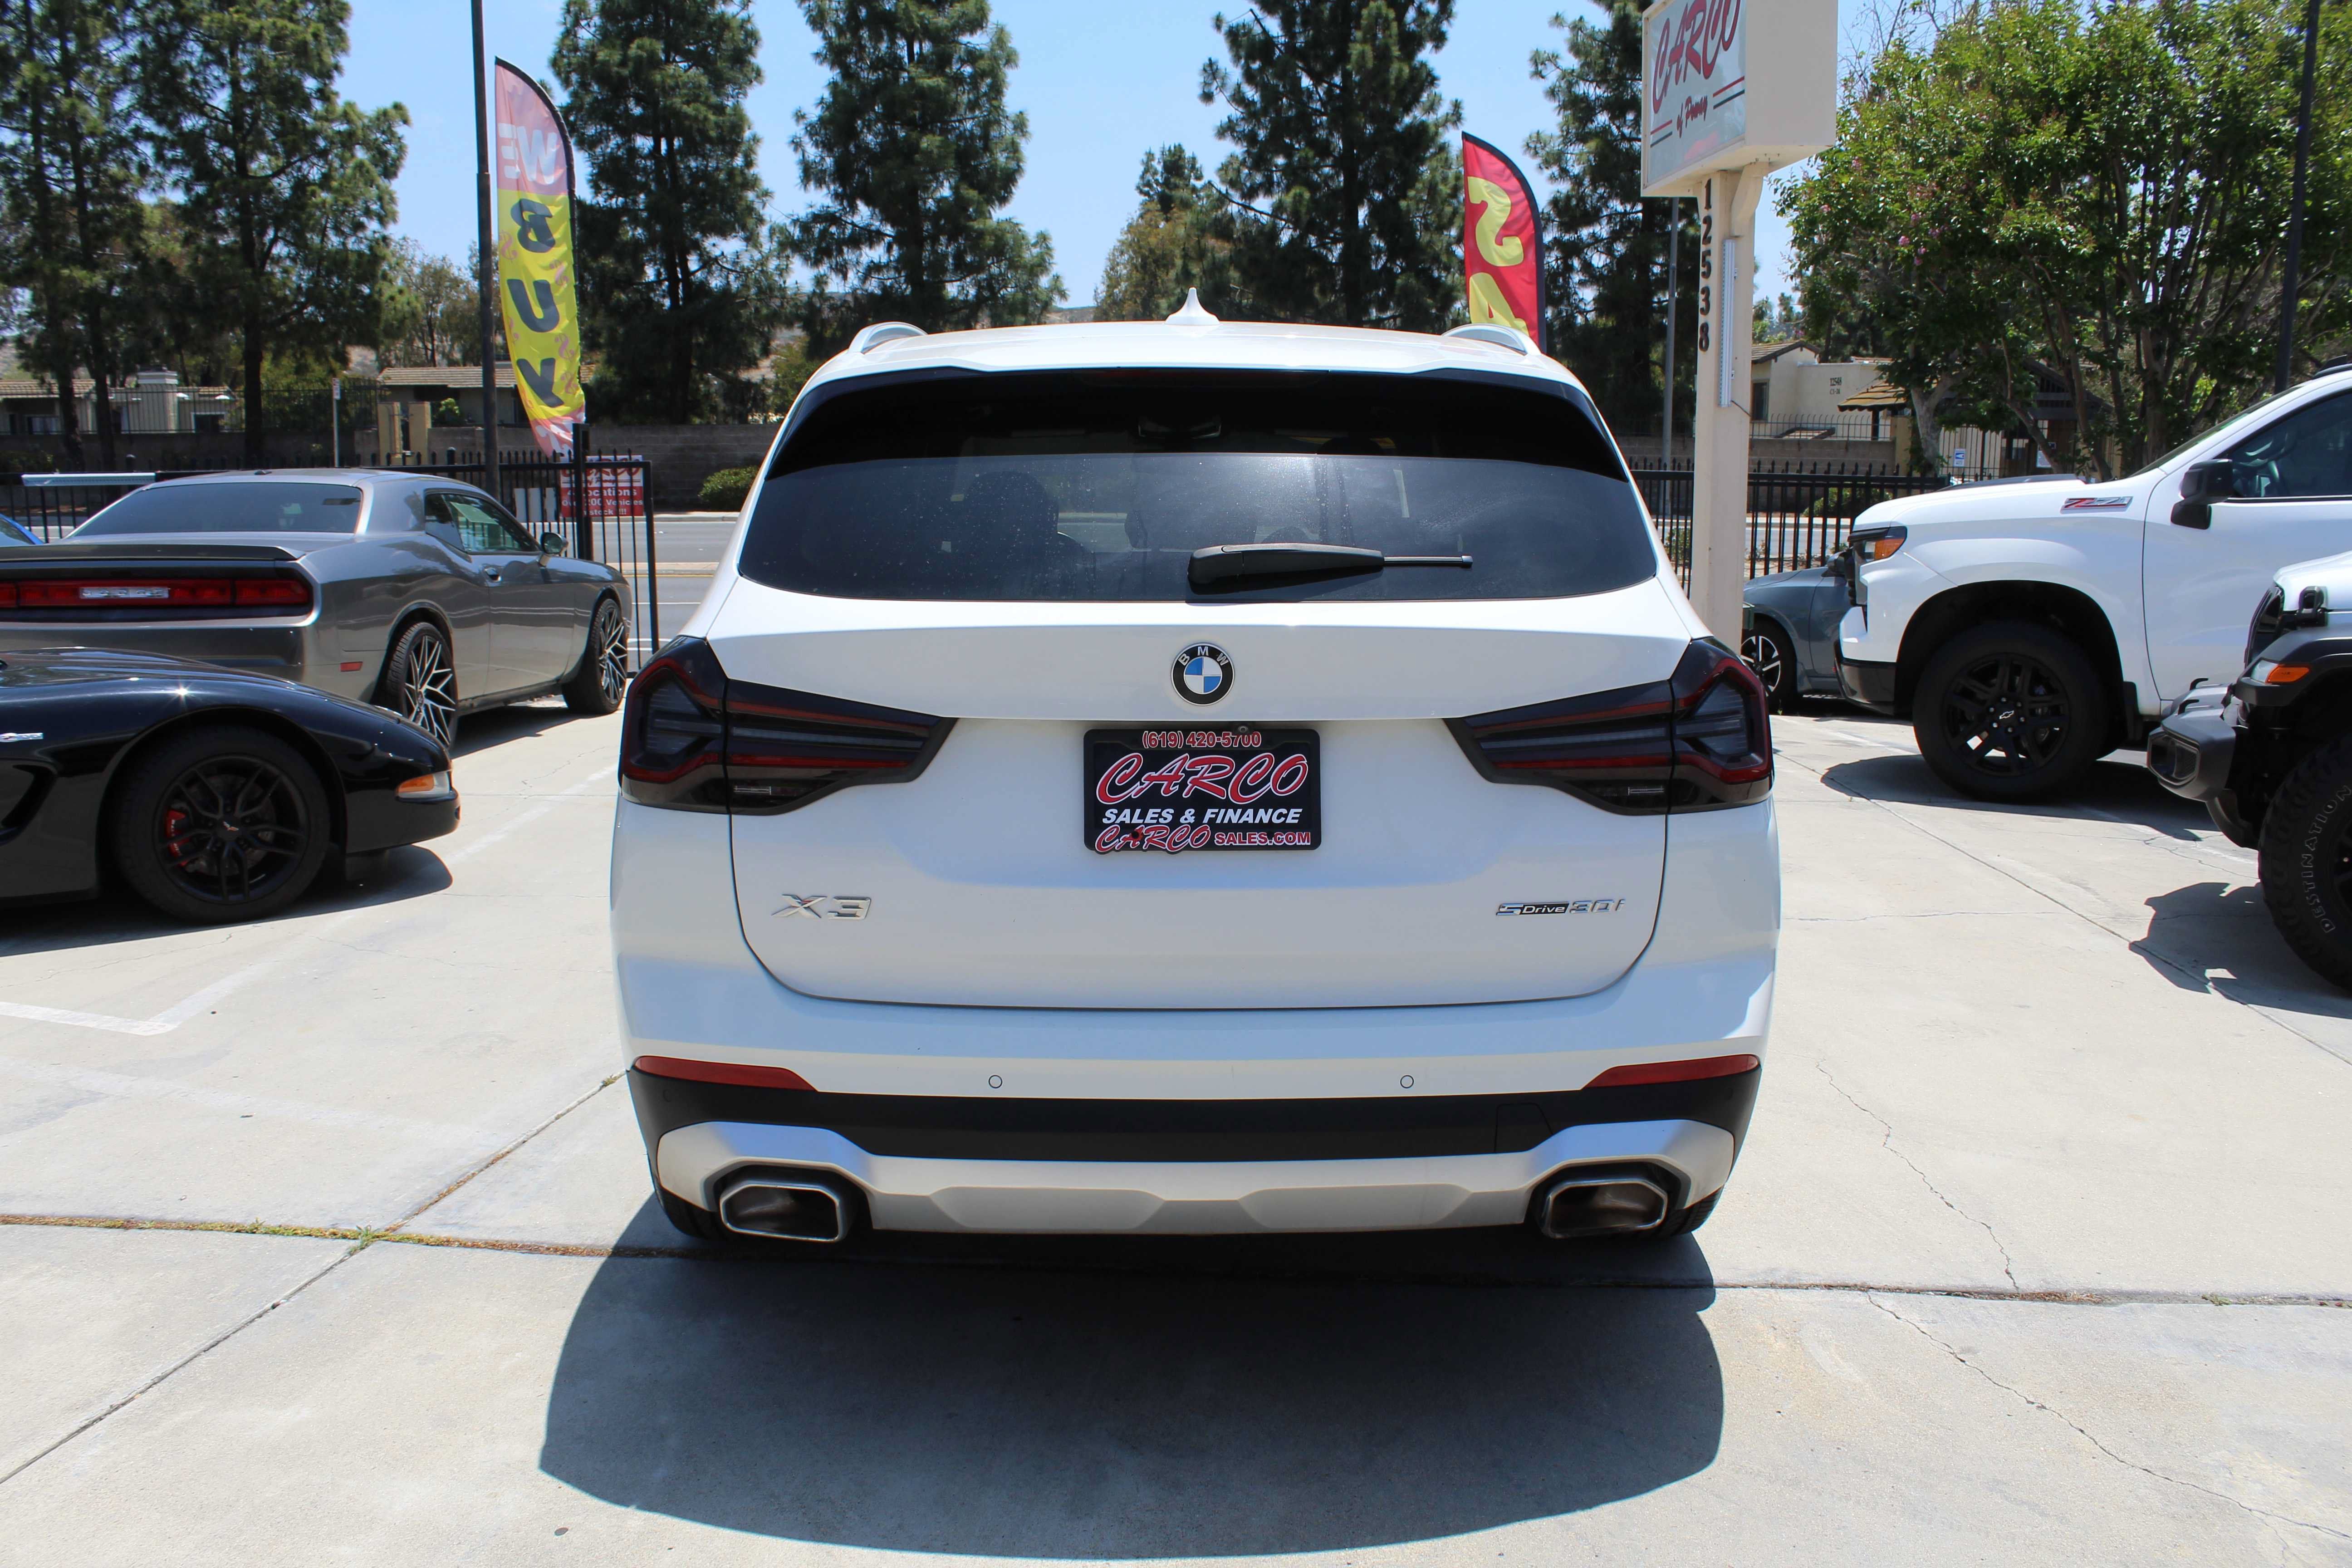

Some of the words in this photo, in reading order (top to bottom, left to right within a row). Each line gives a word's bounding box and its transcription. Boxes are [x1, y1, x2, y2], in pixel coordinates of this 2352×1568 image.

[1653, 0, 1741, 113] CARCO
[1698, 178, 1712, 352] 12538
[583, 488, 637, 496] ocations
[1178, 646, 1229, 666] BMW
[1142, 731, 1184, 749] (619)
[1186, 731, 1262, 748] 420-5700
[1096, 752, 1309, 804] CARCO
[1102, 808, 1174, 823] SALES
[1180, 808, 1196, 823] &
[1202, 808, 1303, 823] FINANCE
[1095, 824, 1211, 852] CARCO
[1214, 831, 1311, 845] SALES.COM
[2301, 785, 2352, 933] DESTINATION
[771, 894, 872, 921] X3
